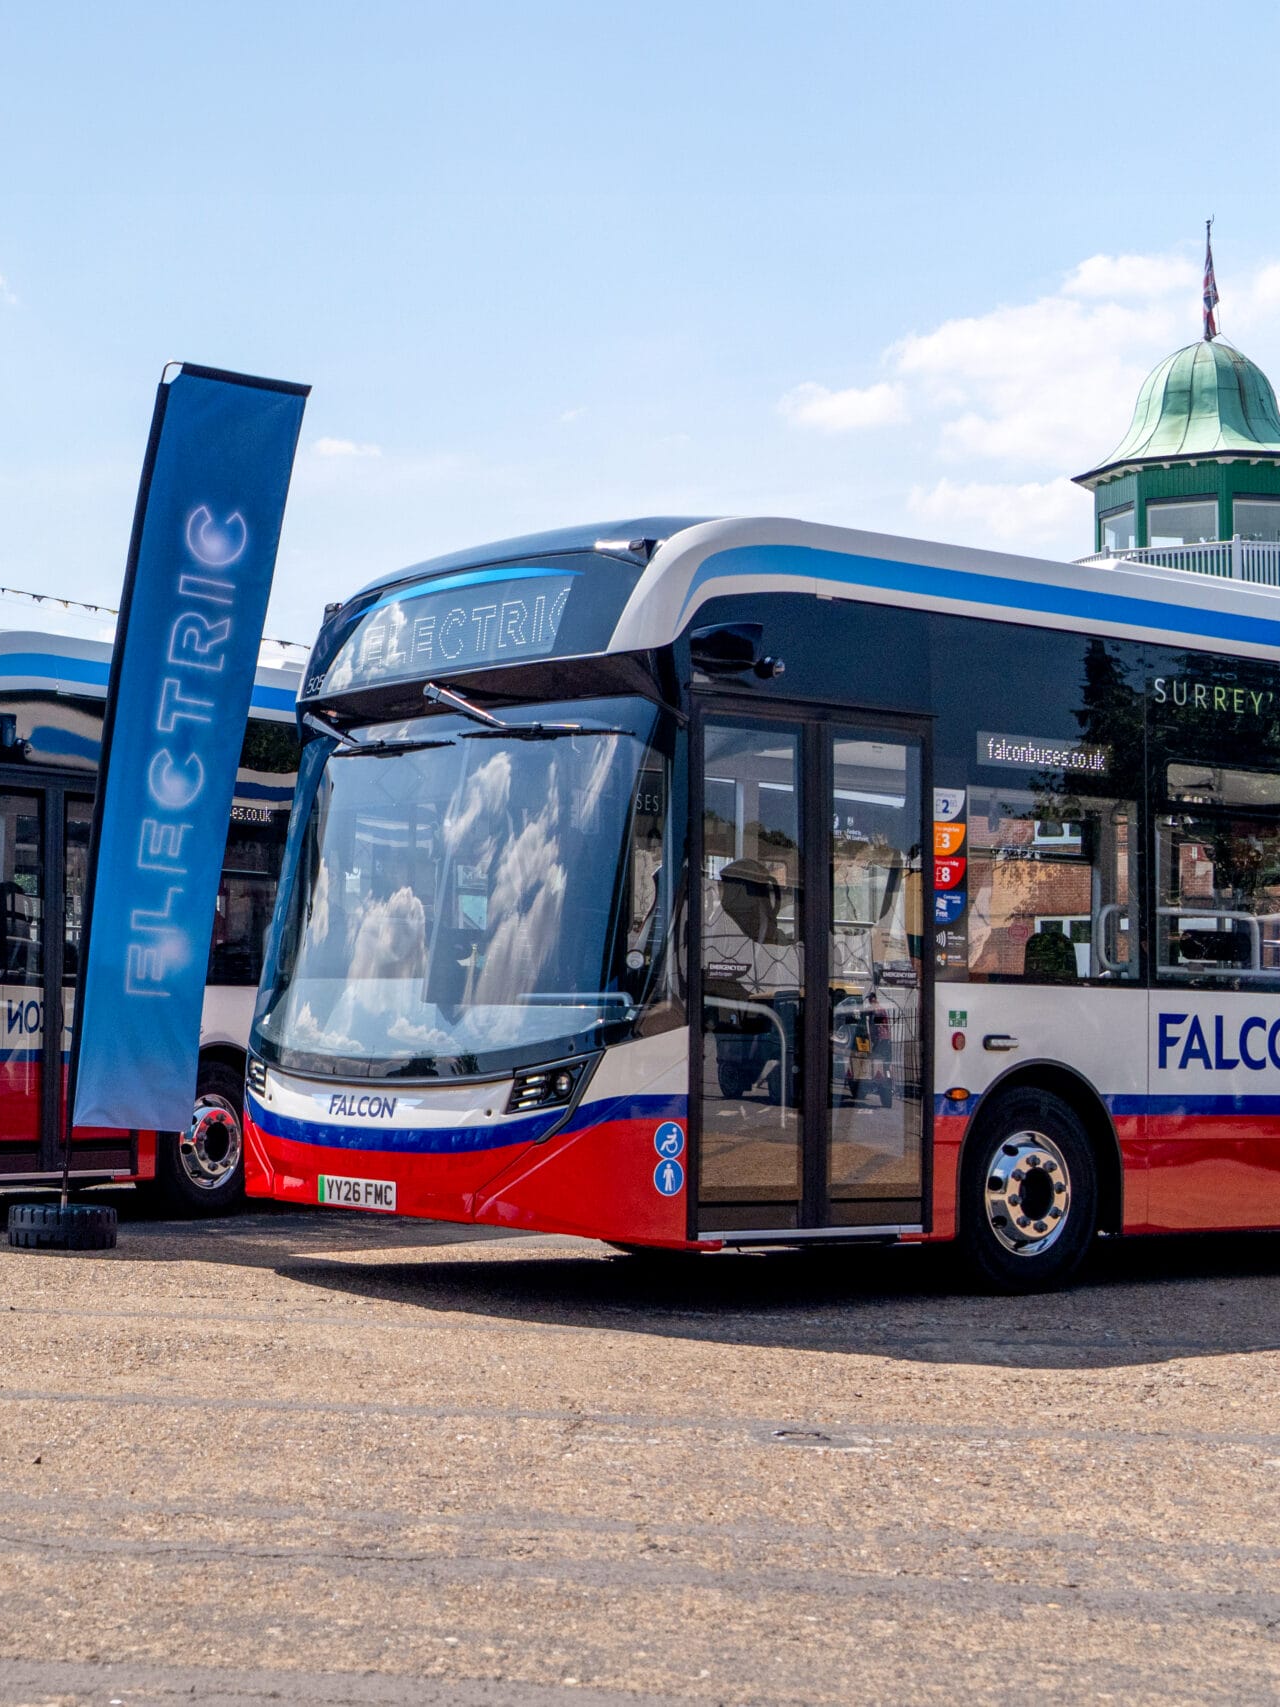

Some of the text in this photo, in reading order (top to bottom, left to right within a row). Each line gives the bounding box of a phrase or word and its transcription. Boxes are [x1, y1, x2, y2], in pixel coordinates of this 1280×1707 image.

[306, 674, 325, 694] 505
[126, 504, 248, 998] ELECTRIC
[987, 738, 1105, 770] falconbuses.co.uk
[231, 806, 271, 822] es.co.uk
[328, 1094, 397, 1118] FALCON
[326, 1178, 393, 1206] YY26 FMC
